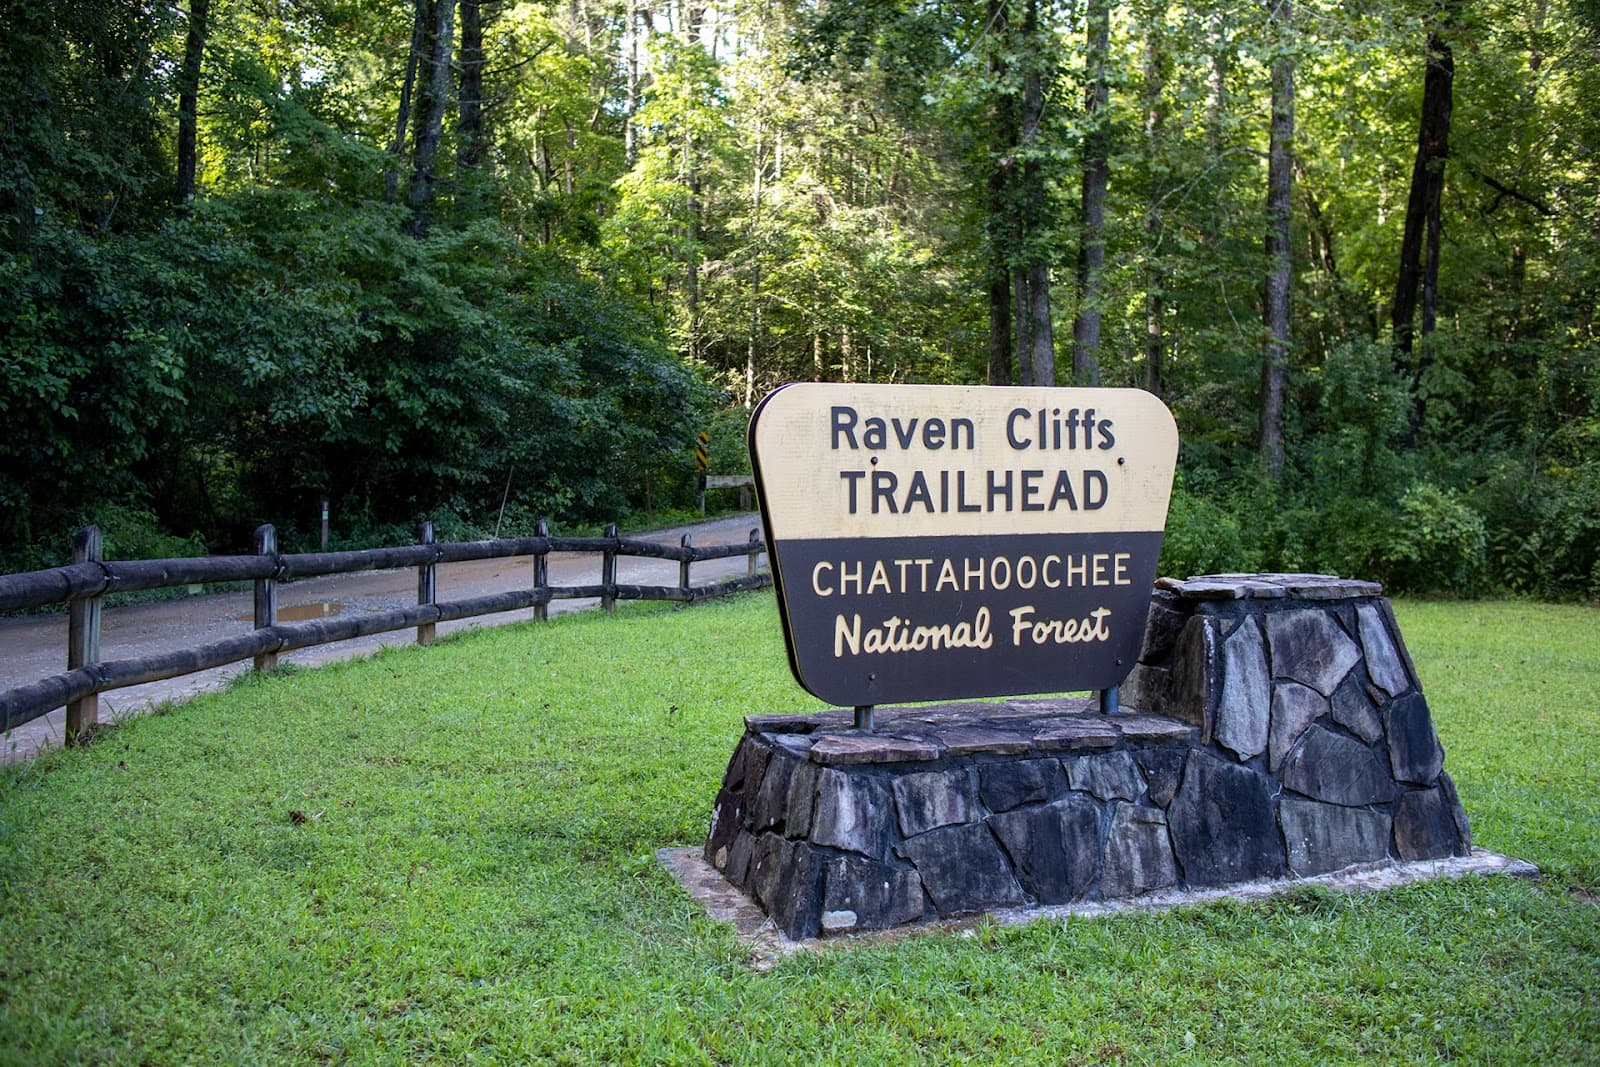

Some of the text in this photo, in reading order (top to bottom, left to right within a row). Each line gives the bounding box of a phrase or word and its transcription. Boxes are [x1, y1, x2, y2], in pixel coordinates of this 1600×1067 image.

[830, 406, 1115, 450] Raven Cliffs
[840, 469, 1109, 514] TRAILHEAD
[812, 552, 1132, 596] CHATTAHOOCHEE
[834, 605, 1112, 657] National Forest
